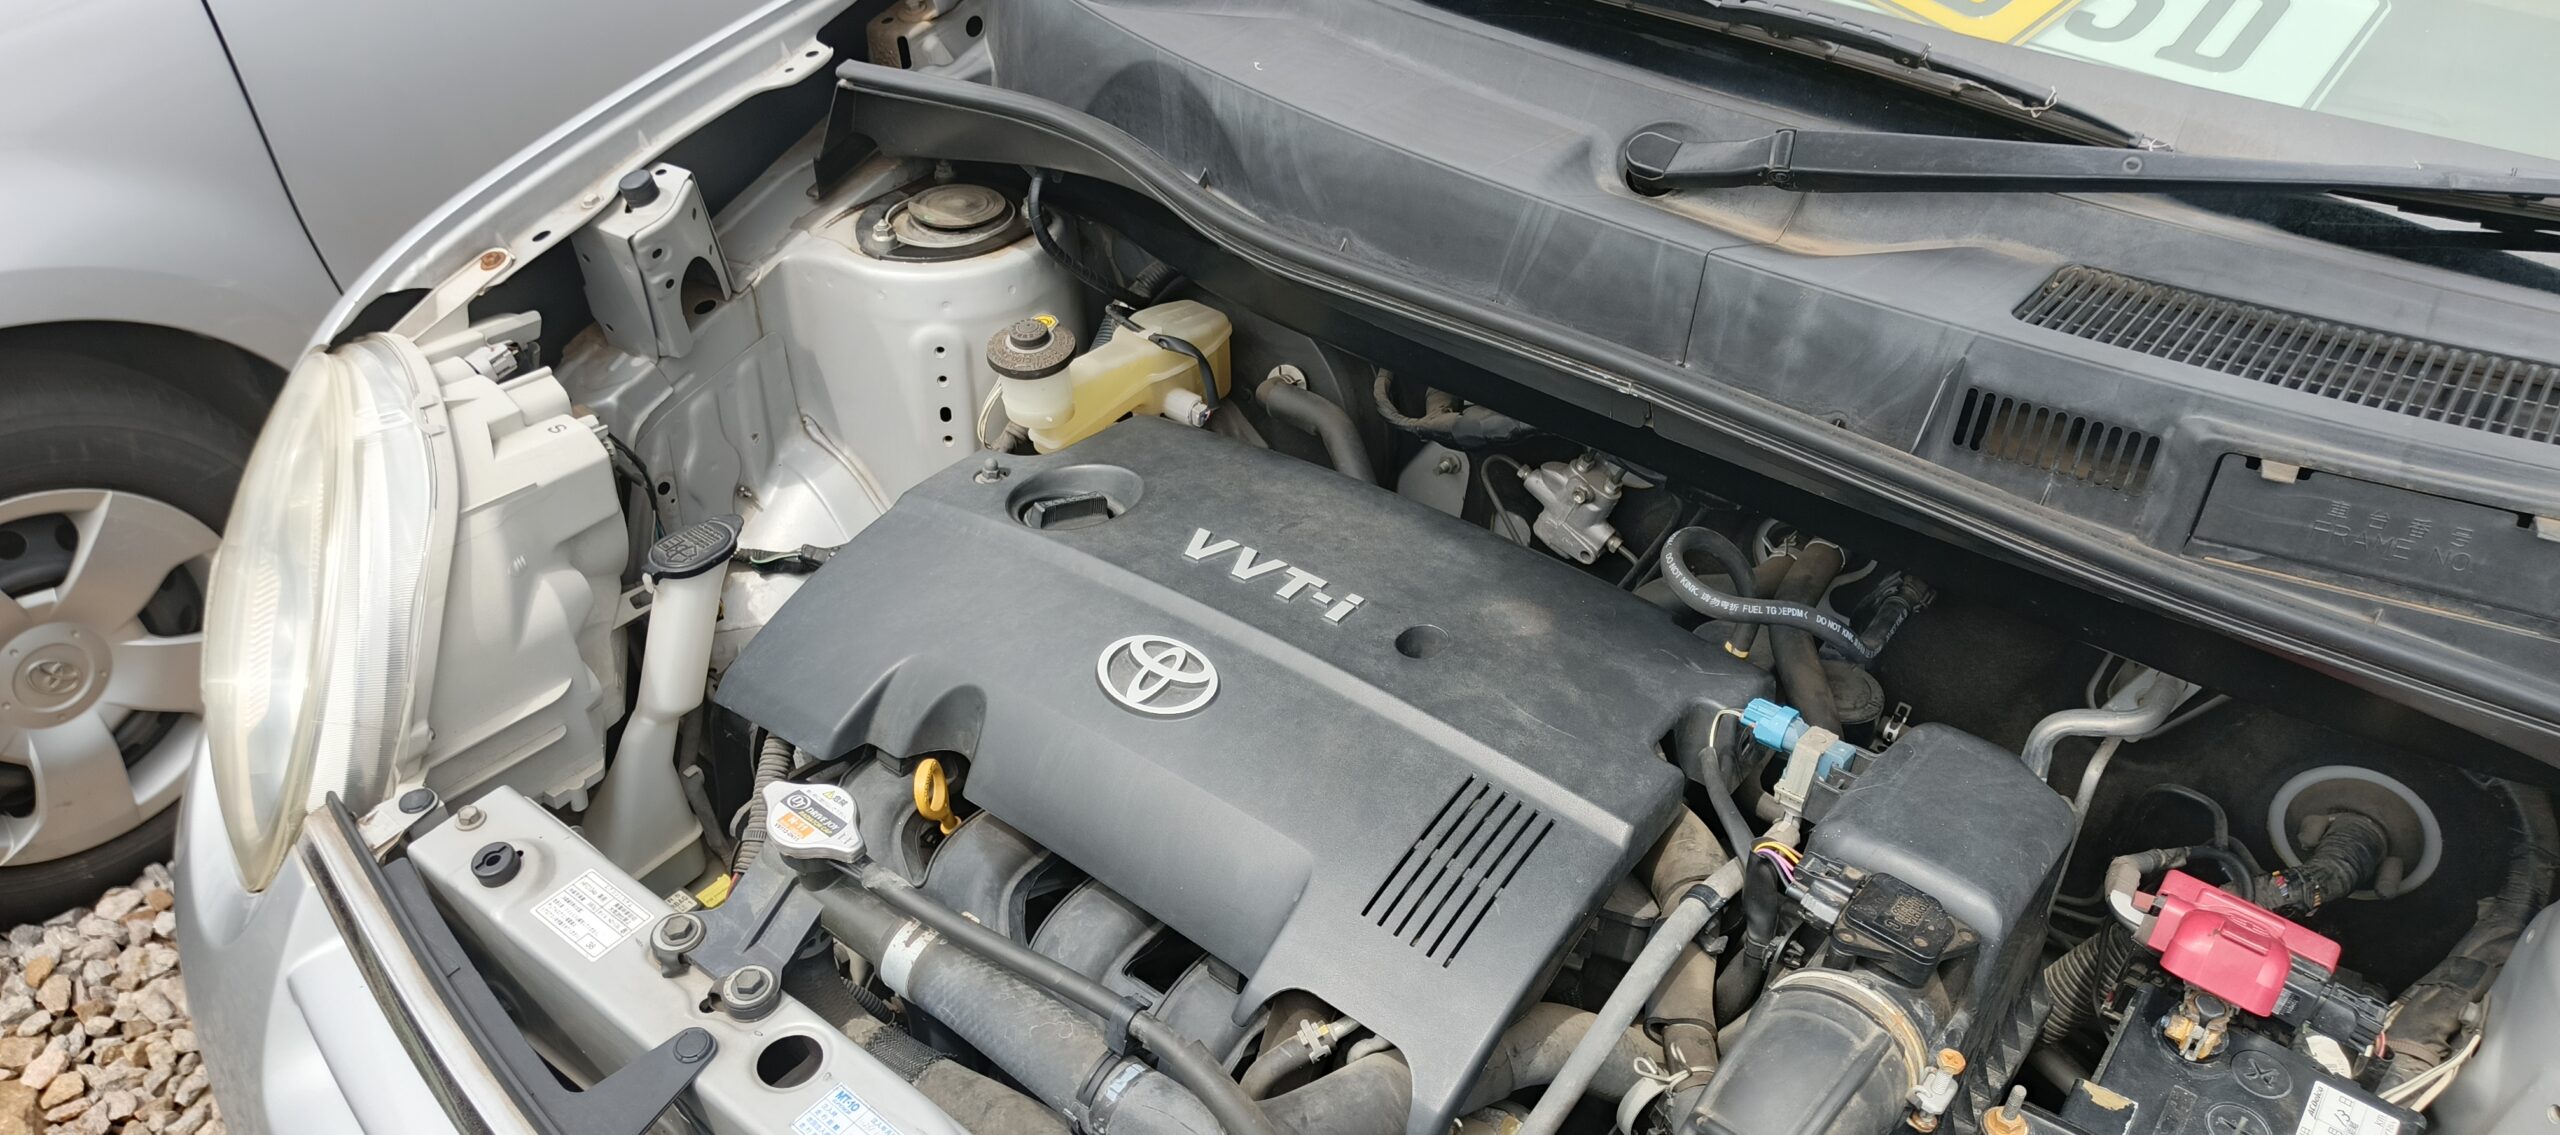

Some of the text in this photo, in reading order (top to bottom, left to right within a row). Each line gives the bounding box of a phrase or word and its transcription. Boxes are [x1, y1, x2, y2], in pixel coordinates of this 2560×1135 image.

[2309, 519, 2417, 561] FRAME
[1183, 527, 1366, 625] VVT-i
[1668, 562, 1683, 579] NOT
[1742, 604, 1764, 614] FUEL
[1765, 605, 1777, 615] TG
[1815, 614, 1827, 626] DO
[1827, 620, 1842, 633] NOT
